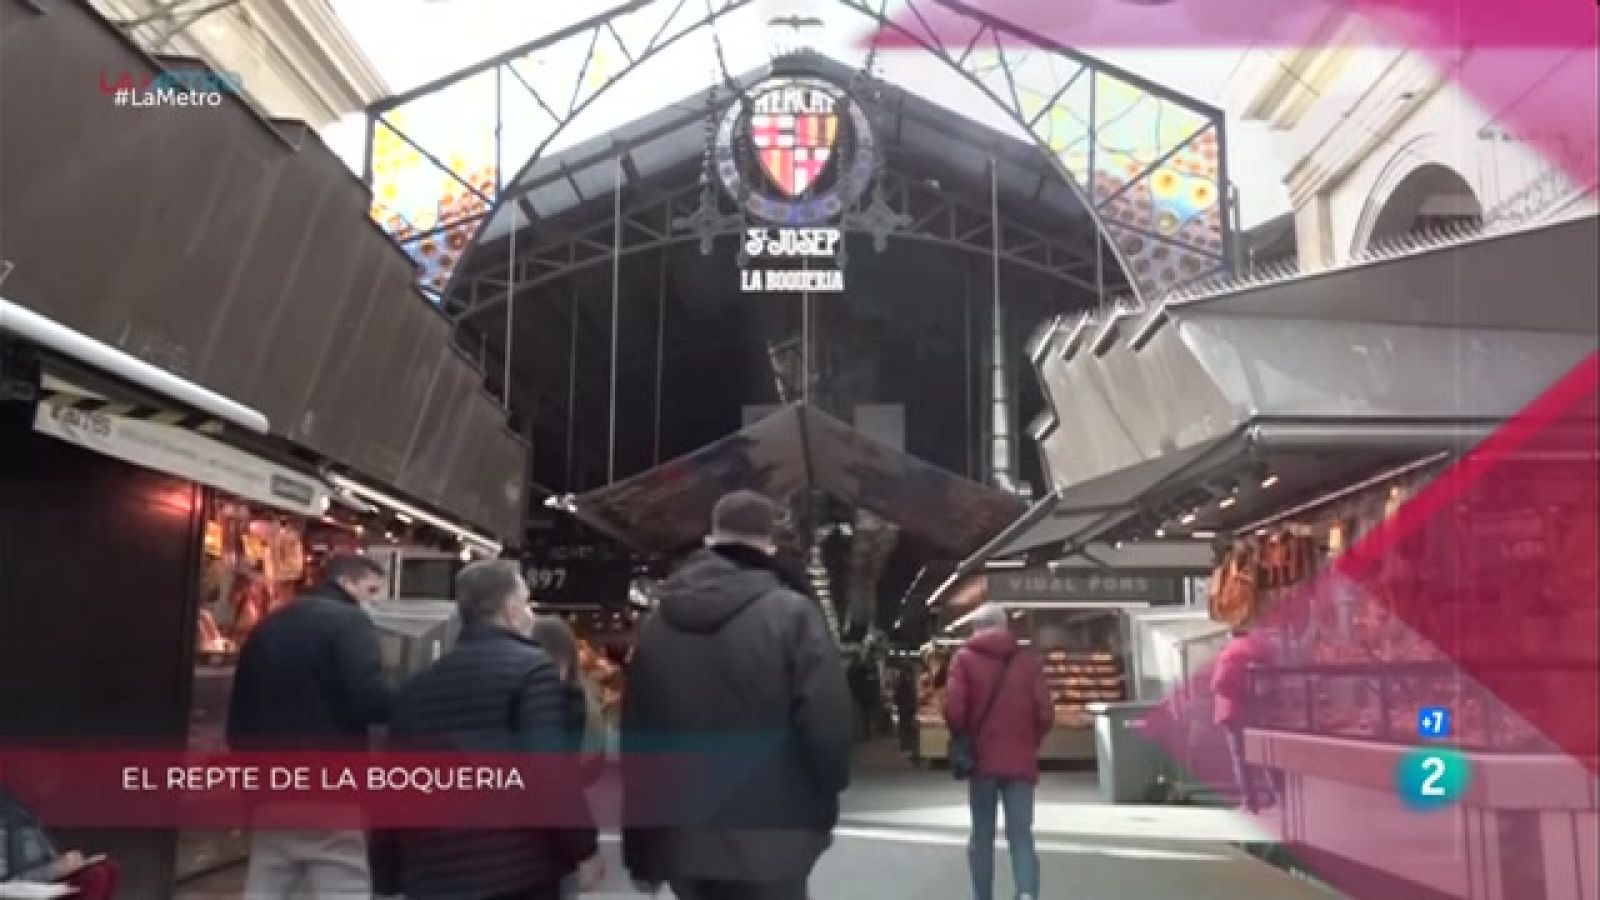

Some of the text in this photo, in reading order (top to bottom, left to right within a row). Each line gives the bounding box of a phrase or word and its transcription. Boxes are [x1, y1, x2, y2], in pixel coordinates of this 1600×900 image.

[767, 228, 841, 256] JOSEP
[741, 269, 845, 292] LA BOQUERIA
[1009, 576, 1077, 592] VIDAL
